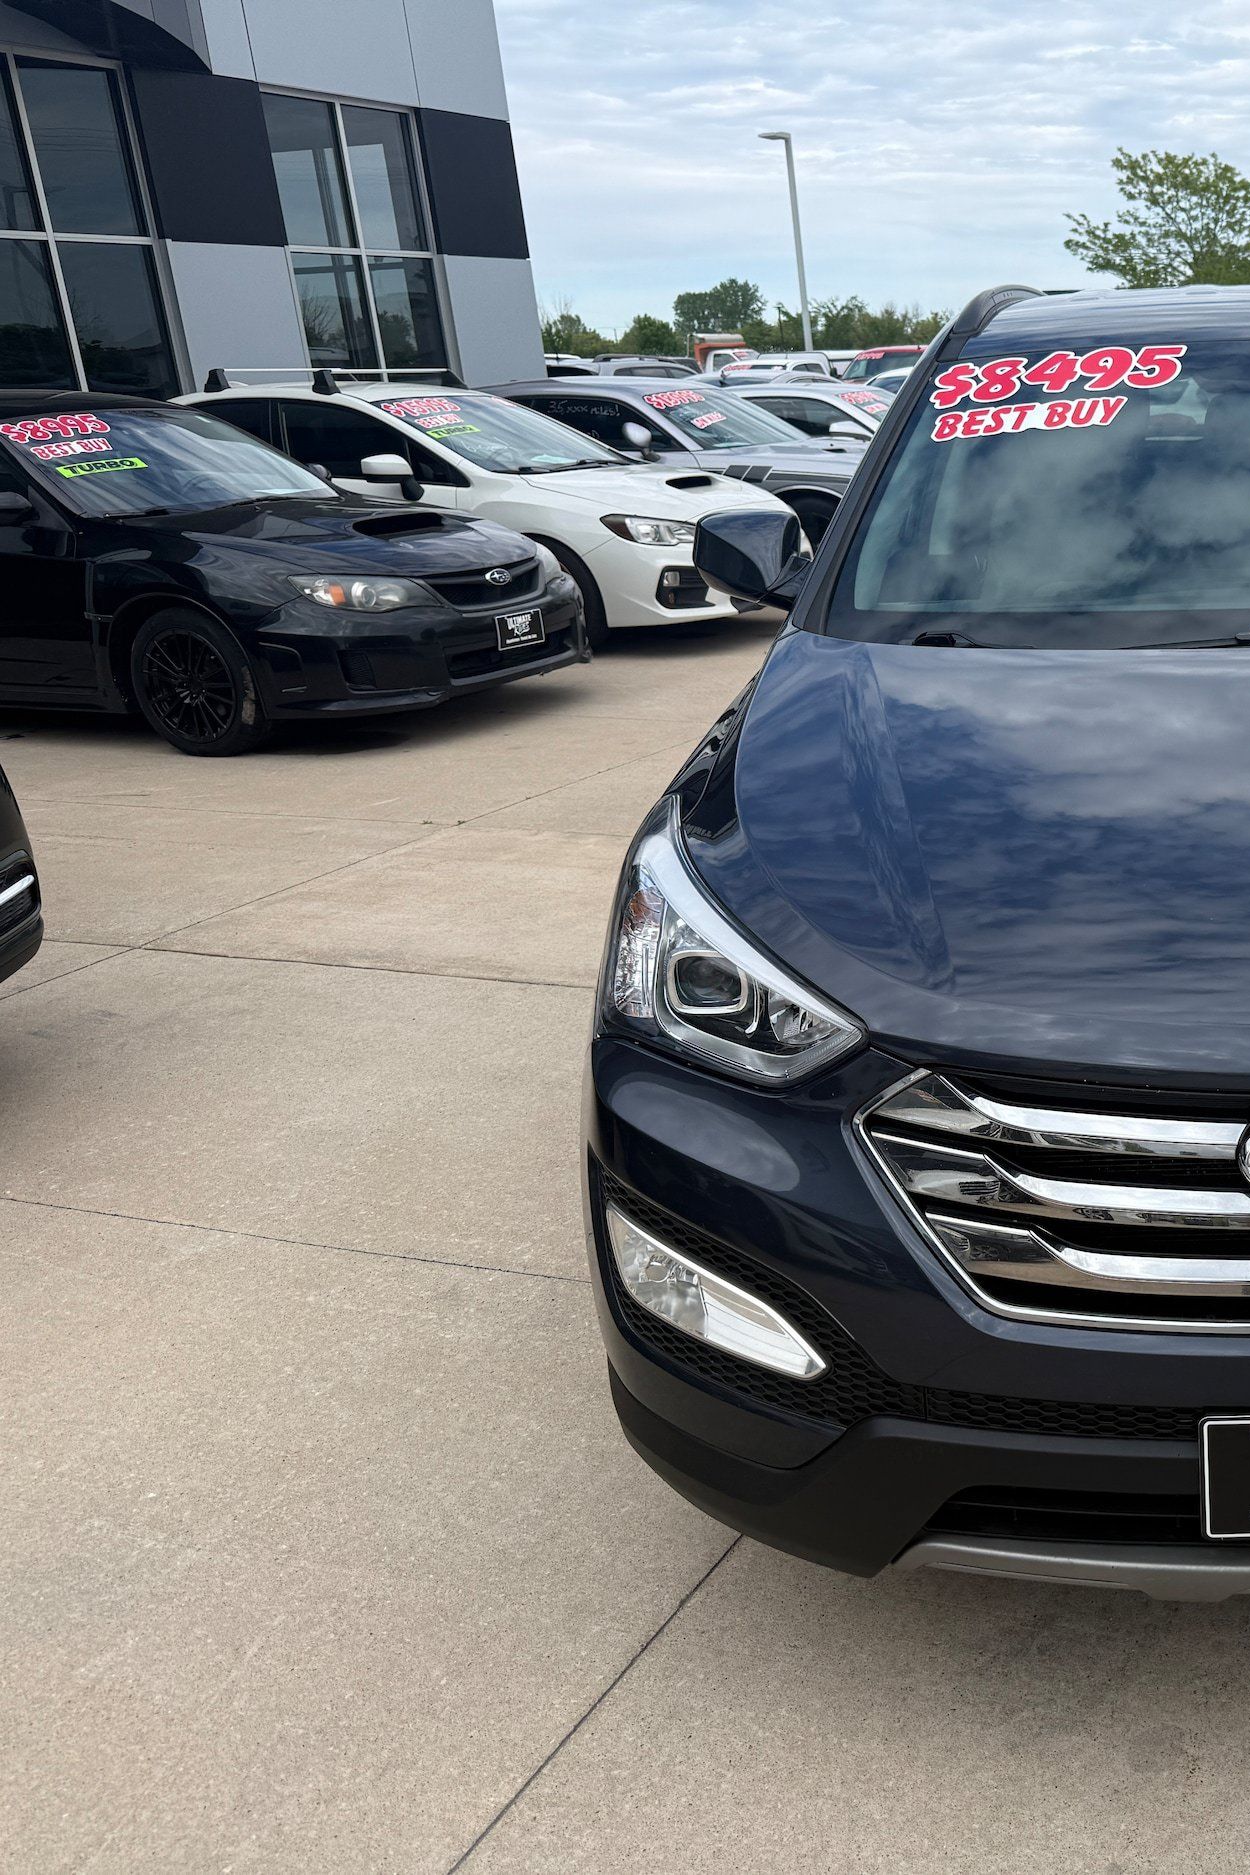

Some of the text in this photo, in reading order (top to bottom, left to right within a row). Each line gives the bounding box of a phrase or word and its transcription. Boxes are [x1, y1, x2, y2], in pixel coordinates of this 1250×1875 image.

[930, 345, 1187, 408] $8495
[0, 414, 110, 443] $8995
[932, 396, 1127, 442] BEST BUY
[31, 438, 112, 460] BEST BUY
[64, 460, 137, 473] TURBO
